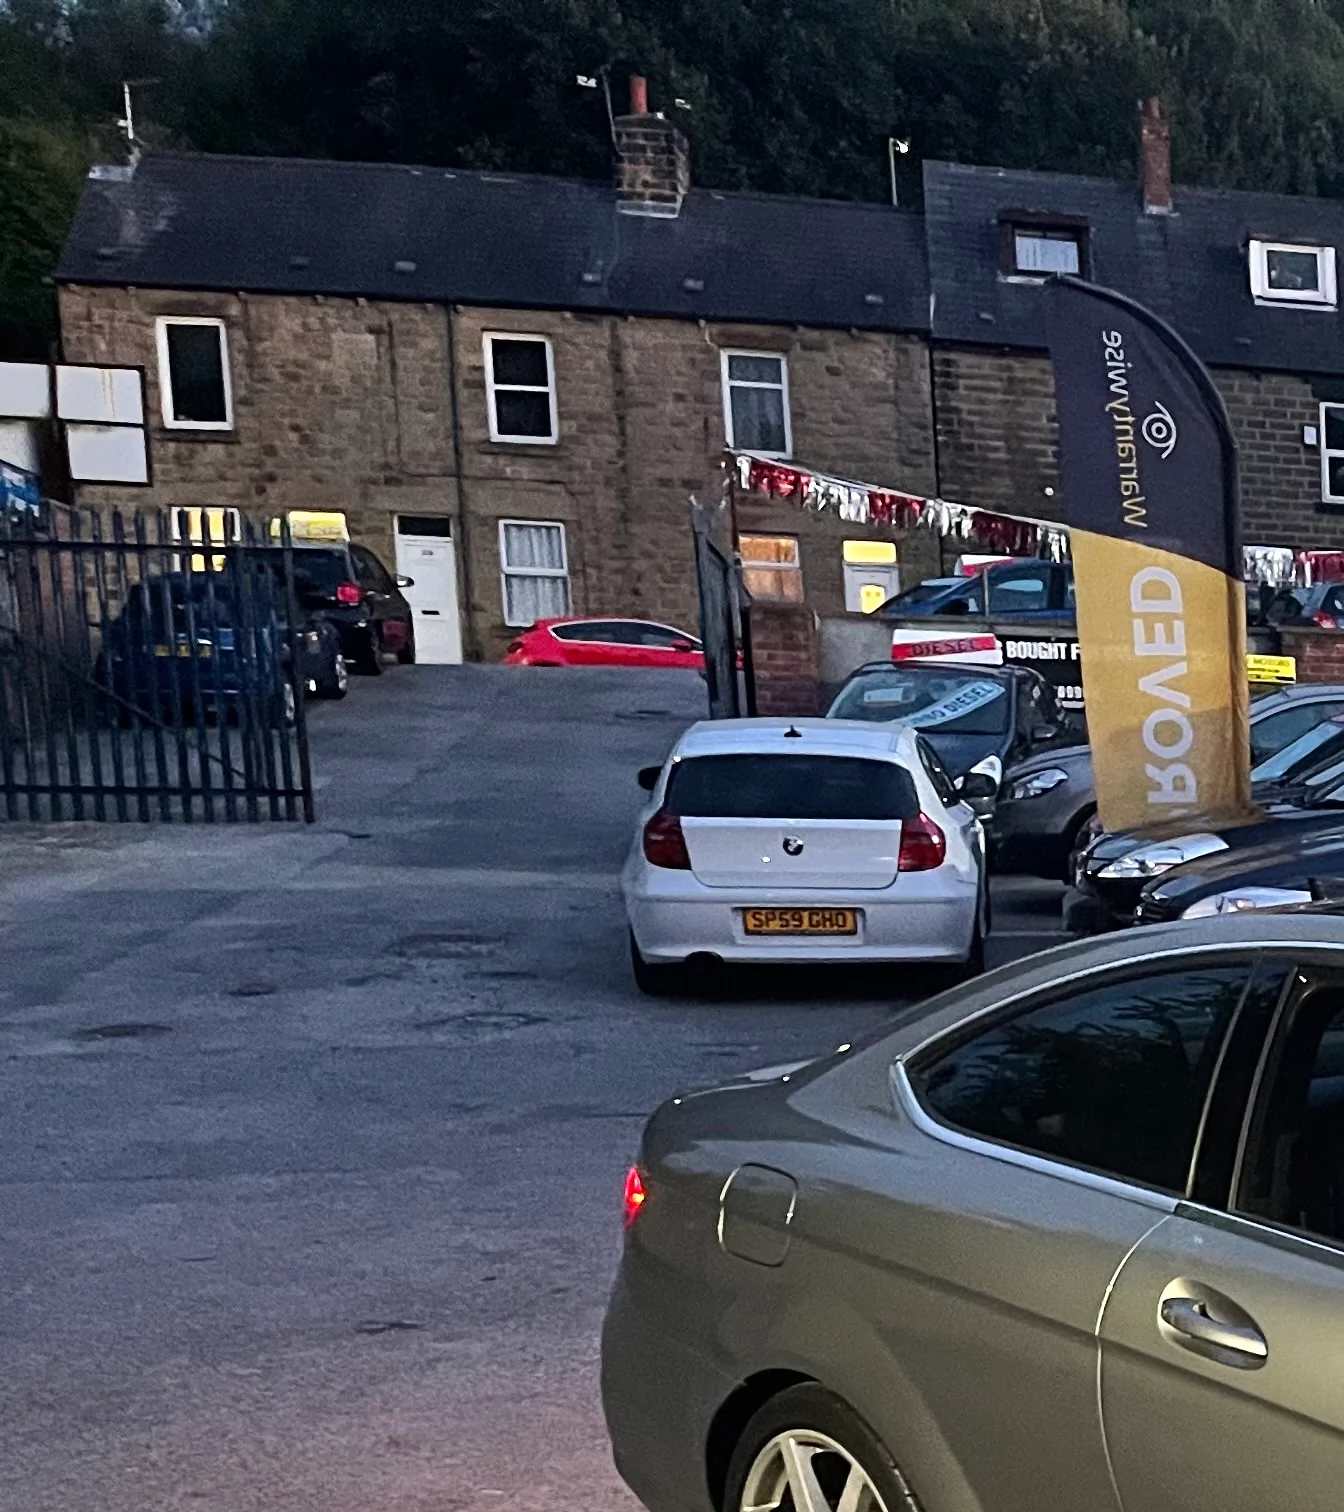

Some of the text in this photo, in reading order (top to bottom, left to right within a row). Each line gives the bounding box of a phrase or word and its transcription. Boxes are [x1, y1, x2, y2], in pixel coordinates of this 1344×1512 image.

[1006, 641, 1067, 660] BOUGHT
[750, 911, 848, 928] SP59 GHO
